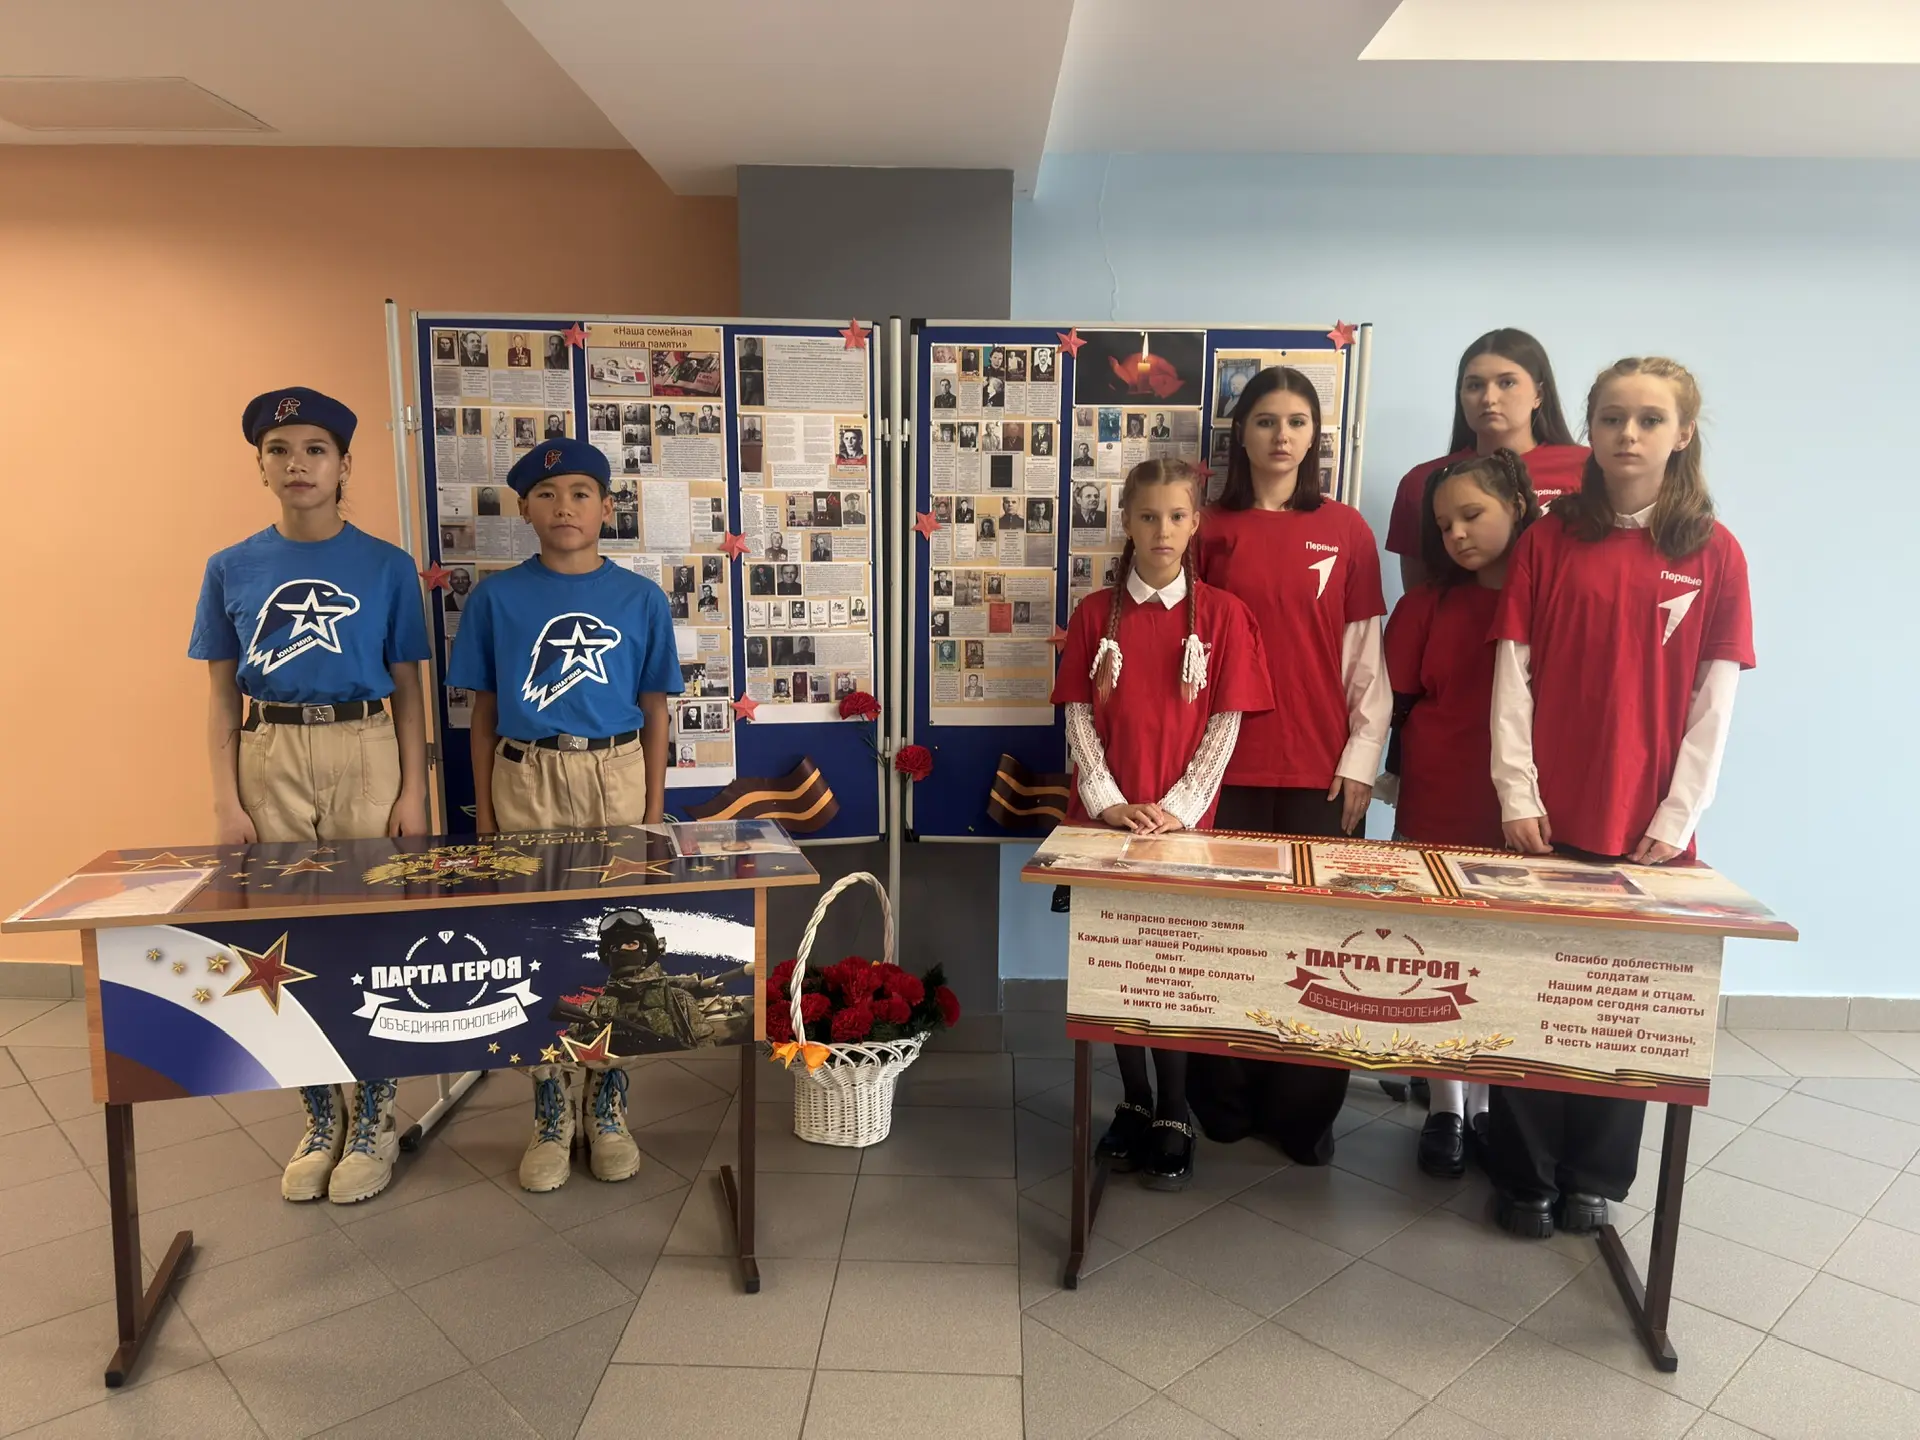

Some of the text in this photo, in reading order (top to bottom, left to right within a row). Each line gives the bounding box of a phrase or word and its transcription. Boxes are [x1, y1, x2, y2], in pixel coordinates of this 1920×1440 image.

[613, 326, 693, 337] «Наша семейная
[619, 340, 688, 349] книга памяти»
[1533, 489, 1562, 498] ервые
[1305, 541, 1339, 552] Первые
[1660, 570, 1702, 586] Первые
[276, 635, 314, 659] ЮНАРМИЯ
[550, 668, 583, 693] ЮНАРМИЯ
[1100, 910, 1245, 931] Не напрасно весною земля
[1077, 932, 1268, 958] Каждый шаг нашей Родины кровью
[1155, 952, 1186, 962] омыт.
[1305, 948, 1460, 980] ПАРТА ГЕРОЯ
[1555, 952, 1694, 974] Спасибо доблестным
[371, 956, 522, 989] ПАРТА ГЕРОЯ
[1088, 957, 1255, 982] В день Победы о мире солдаты
[1587, 970, 1649, 984] солдатам
[1120, 984, 1127, 993] И
[1130, 987, 1160, 997] ничто
[1163, 990, 1175, 998] не
[1145, 976, 1194, 989] мечтают,
[1548, 980, 1696, 1002] Нашим дедам и отцам.
[1123, 998, 1216, 1015] и никто не забыт.
[1382, 1004, 1451, 1018] ПОКОЛЕНИЯ
[1537, 992, 1705, 1017] Недаром сегодня салюты
[452, 1006, 518, 1031] ПОКОЛЕНИЯ
[1597, 1013, 1641, 1025] звучат
[1540, 1020, 1696, 1045] В честь нашей Отчизны,
[1545, 1034, 1690, 1058] В честь наших солдат!
